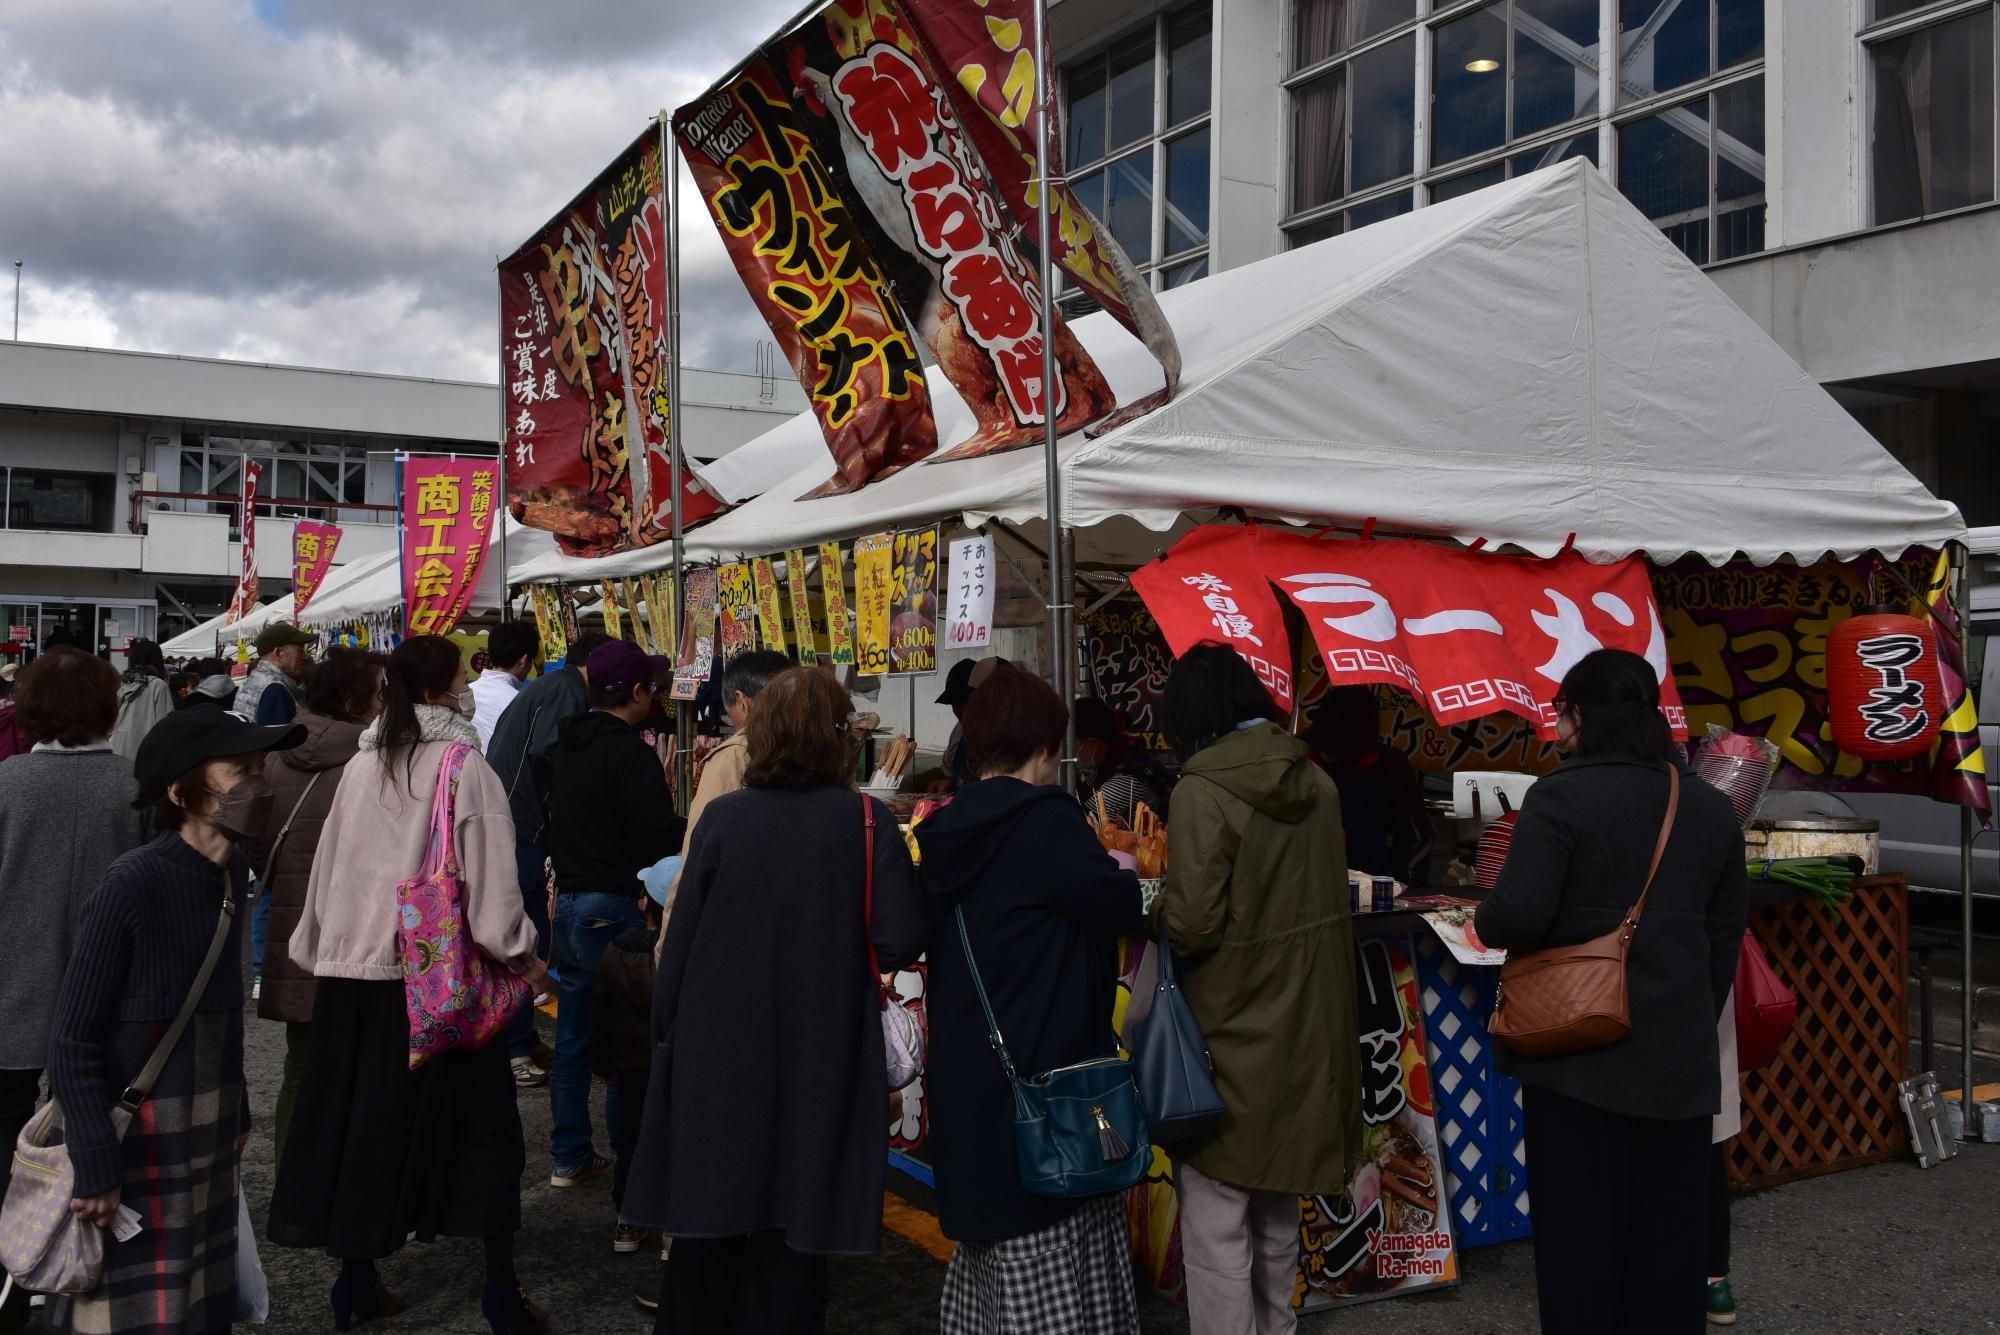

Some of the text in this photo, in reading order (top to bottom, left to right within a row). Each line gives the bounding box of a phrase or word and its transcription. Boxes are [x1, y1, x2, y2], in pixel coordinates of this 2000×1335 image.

[701, 112, 755, 166] Wiener
[521, 271, 561, 402] 是非一度
[511, 314, 541, 467] ご賞味あれ
[894, 529, 937, 564] サツマ
[974, 543, 987, 599] おさつ
[872, 561, 886, 617] 紅芋
[959, 544, 974, 620] チップス
[1181, 572, 1263, 647] 味自慢
[949, 621, 988, 645] 400円
[1280, 572, 1668, 686] ラーメン
[1855, 633, 1930, 743] ラーメン
[1367, 1228, 1452, 1258] Yamagata
[1377, 1253, 1444, 1279] Ra-men
